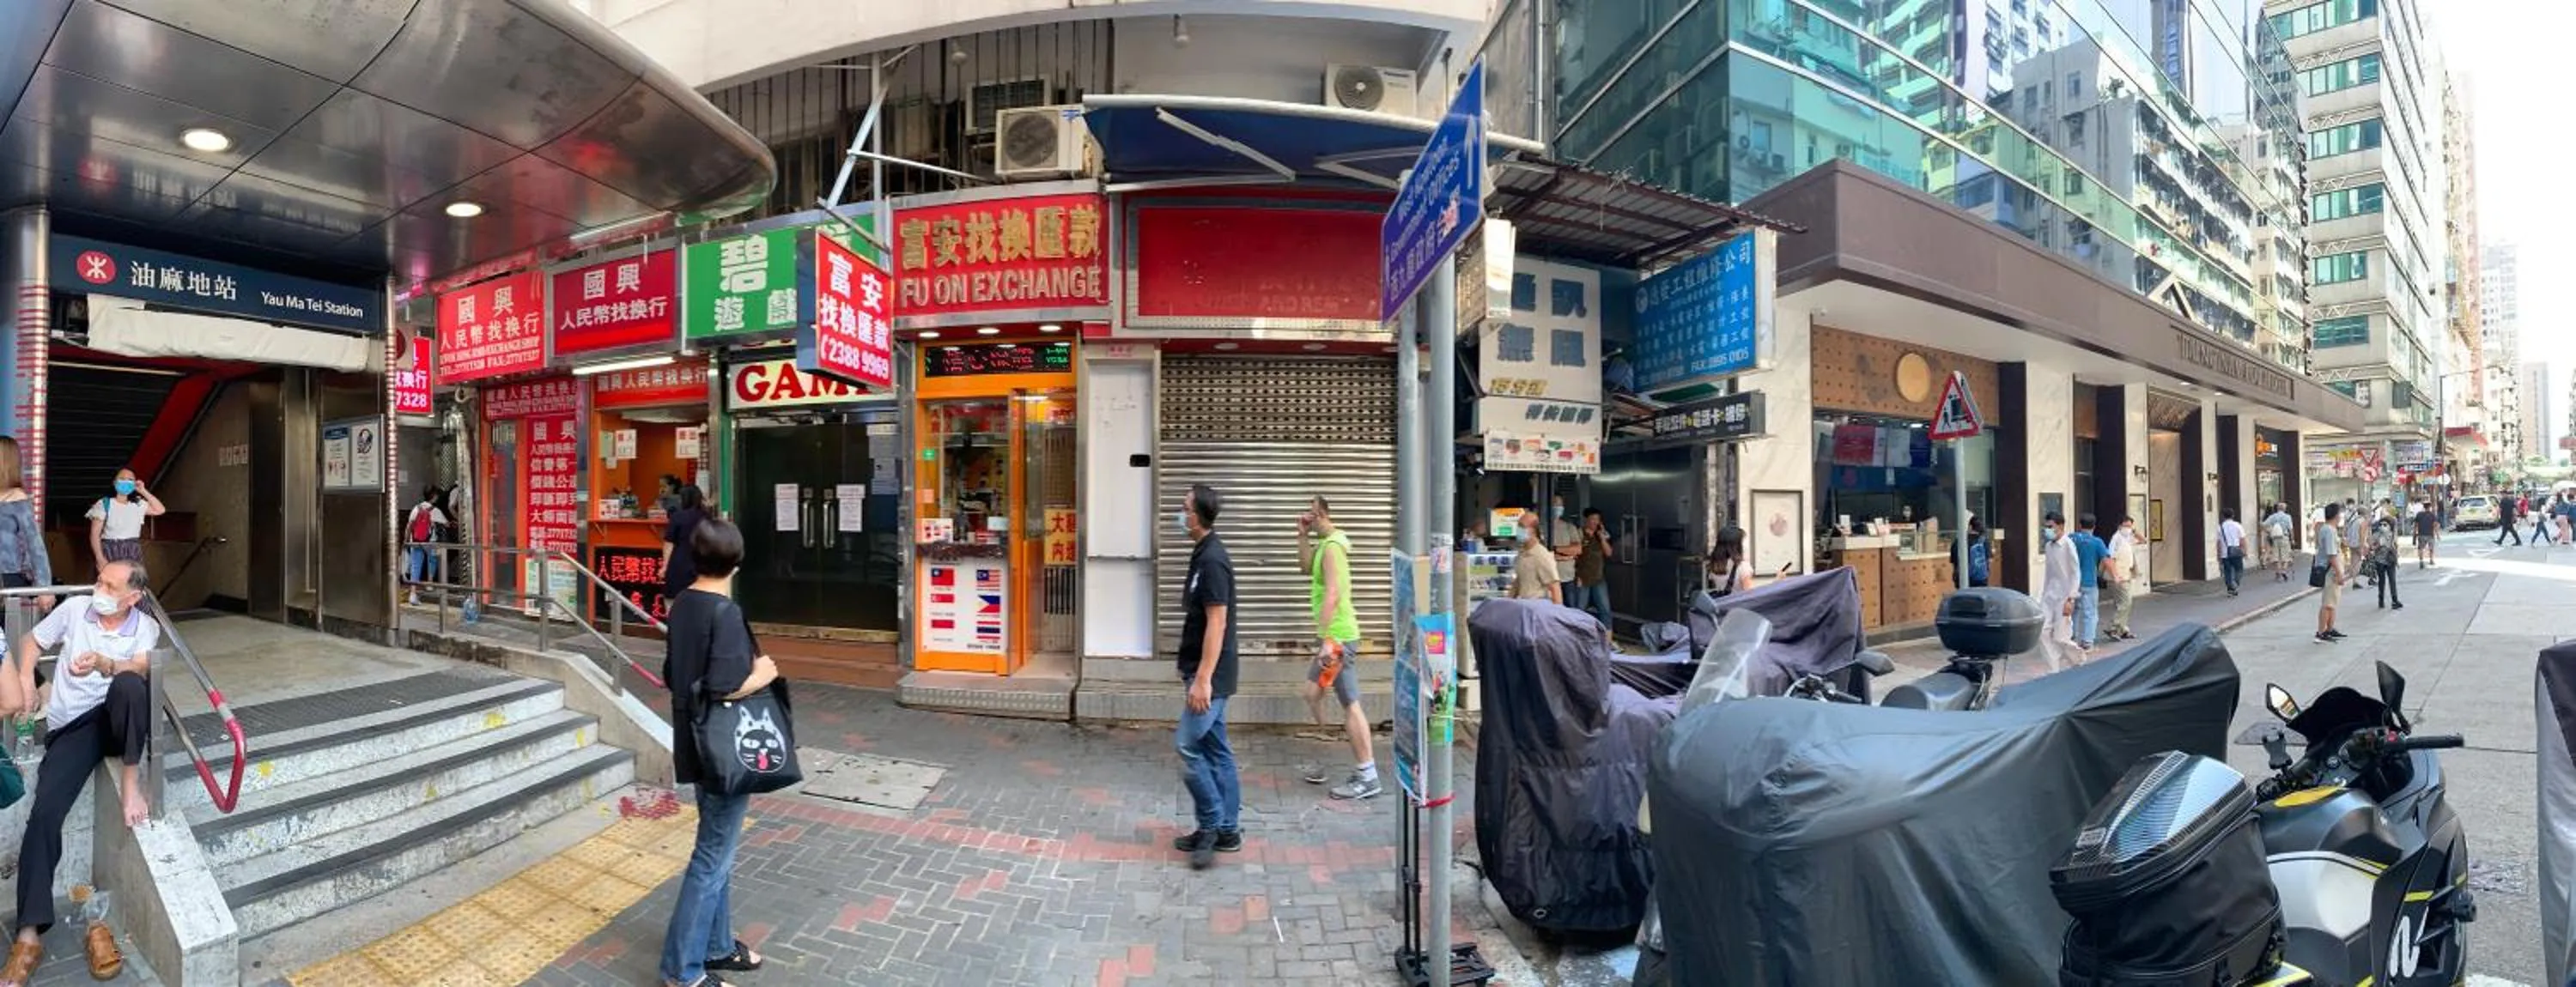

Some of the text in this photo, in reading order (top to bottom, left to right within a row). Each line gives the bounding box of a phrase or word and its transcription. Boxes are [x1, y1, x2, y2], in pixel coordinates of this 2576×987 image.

[900, 203, 1101, 270] 富安找換匯款
[130, 260, 237, 300] 油麻地站
[583, 262, 641, 300] 國興
[720, 233, 769, 294] 碧
[827, 250, 884, 313] 富安
[261, 291, 363, 318] Yau Ma Tei Station
[457, 285, 513, 326] 國興
[901, 264, 1102, 308] FU ON EXCHANGE
[439, 312, 540, 353] 人民幣找換行
[560, 296, 668, 330] 人民幣找換行
[820, 293, 890, 352] 找換匯款
[828, 337, 860, 370] 2388
[396, 391, 428, 408] 7328
[735, 363, 874, 402] GAM
